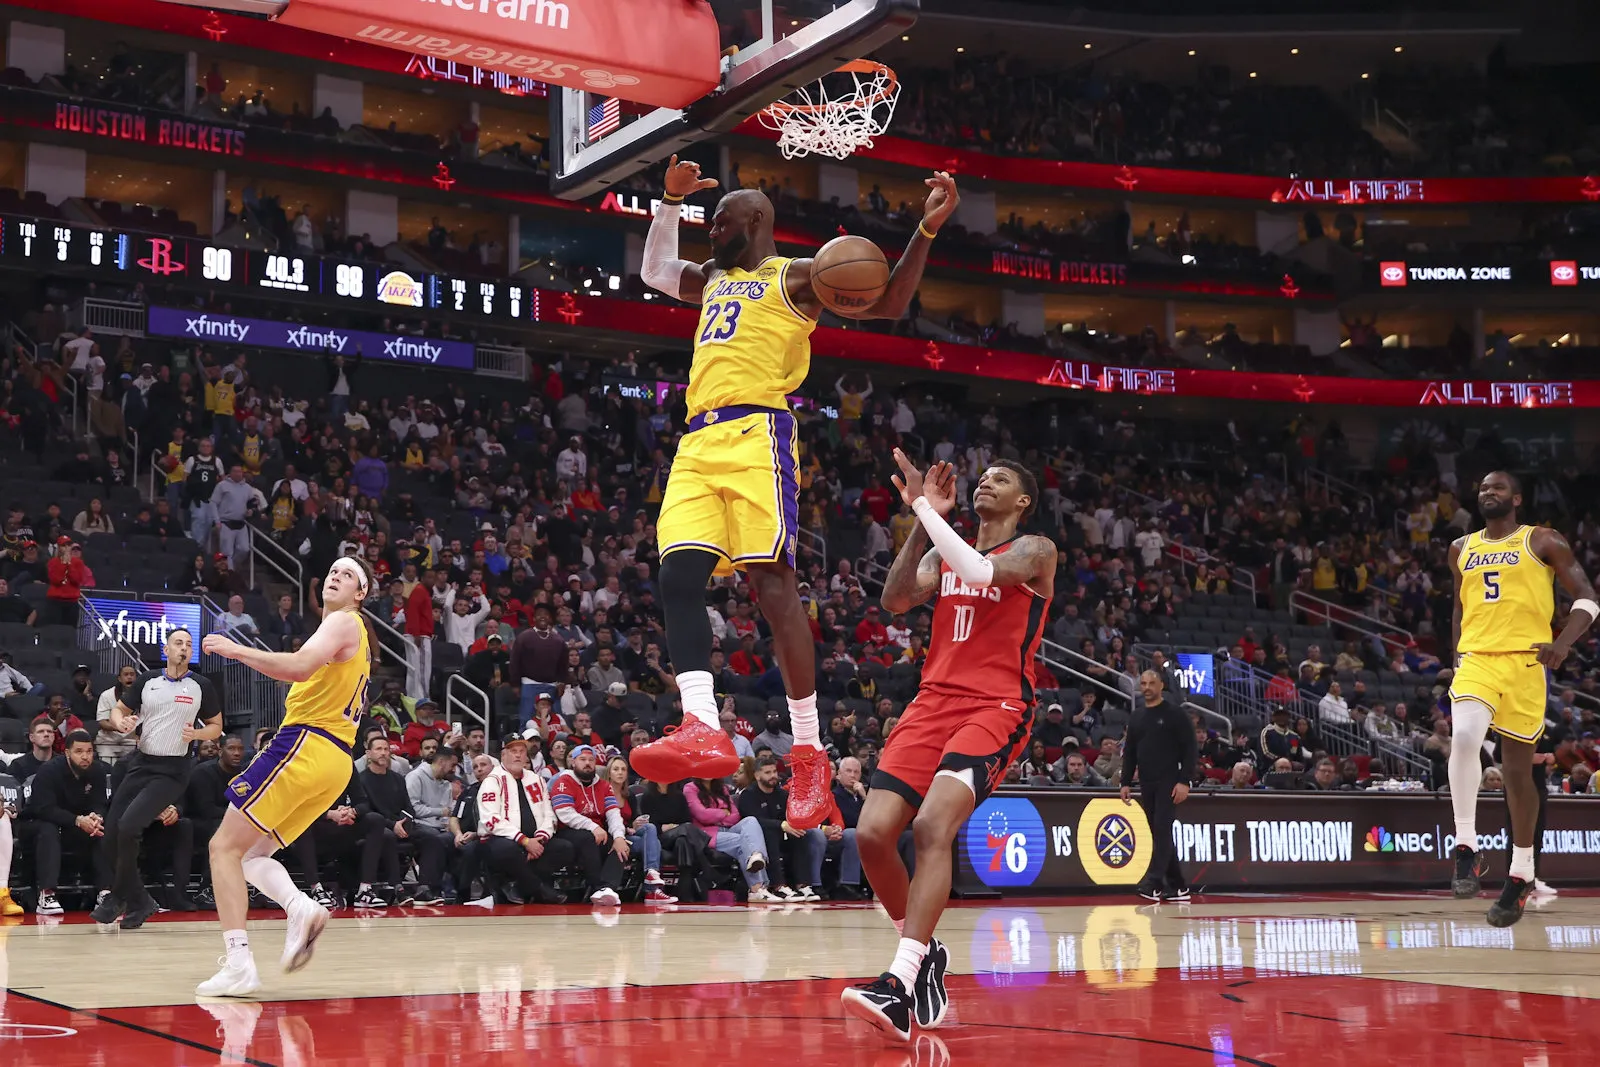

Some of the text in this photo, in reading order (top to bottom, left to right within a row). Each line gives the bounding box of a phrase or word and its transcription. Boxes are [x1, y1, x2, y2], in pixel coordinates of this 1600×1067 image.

[356, 25, 579, 79] StateFarm
[55, 102, 246, 156] HOUSTON ROCKETS
[1286, 179, 1424, 201] ALL FIRE
[600, 191, 705, 224] ALL FRE
[54, 227, 71, 242] FLS
[24, 237, 31, 257] 1
[57, 241, 68, 261] 3
[202, 246, 363, 298] 90 40.3 98
[992, 251, 1127, 285] HOUSTON ROCKETS
[1409, 267, 1511, 280] TUNDRA ZONE
[455, 292, 464, 311] 2
[483, 296, 493, 314] 5
[705, 279, 770, 304] LAKERS
[186, 315, 250, 341] xfinity
[698, 300, 742, 345] 23
[286, 326, 348, 351] xfinity
[383, 337, 442, 362] xfinity
[1048, 359, 1175, 392] ALL FIRE
[1419, 382, 1573, 404] ALL FIRE
[201, 471, 209, 483] 6
[1463, 551, 1520, 571] LAKERS
[1483, 571, 1500, 601] 5
[97, 610, 188, 648] xfinit
[952, 605, 976, 642] 10
[482, 792, 496, 802] 22
[525, 782, 544, 804] H
[485, 816, 500, 831] 34
[986, 832, 1028, 873] 76
[1052, 825, 1072, 857] VS
[1215, 823, 1236, 862] ET
[1246, 820, 1353, 862] TOMORROW
[1395, 828, 1509, 859] NBC pcock
[1556, 830, 1585, 853] LOCAL
[1585, 830, 1600, 853] LIS
